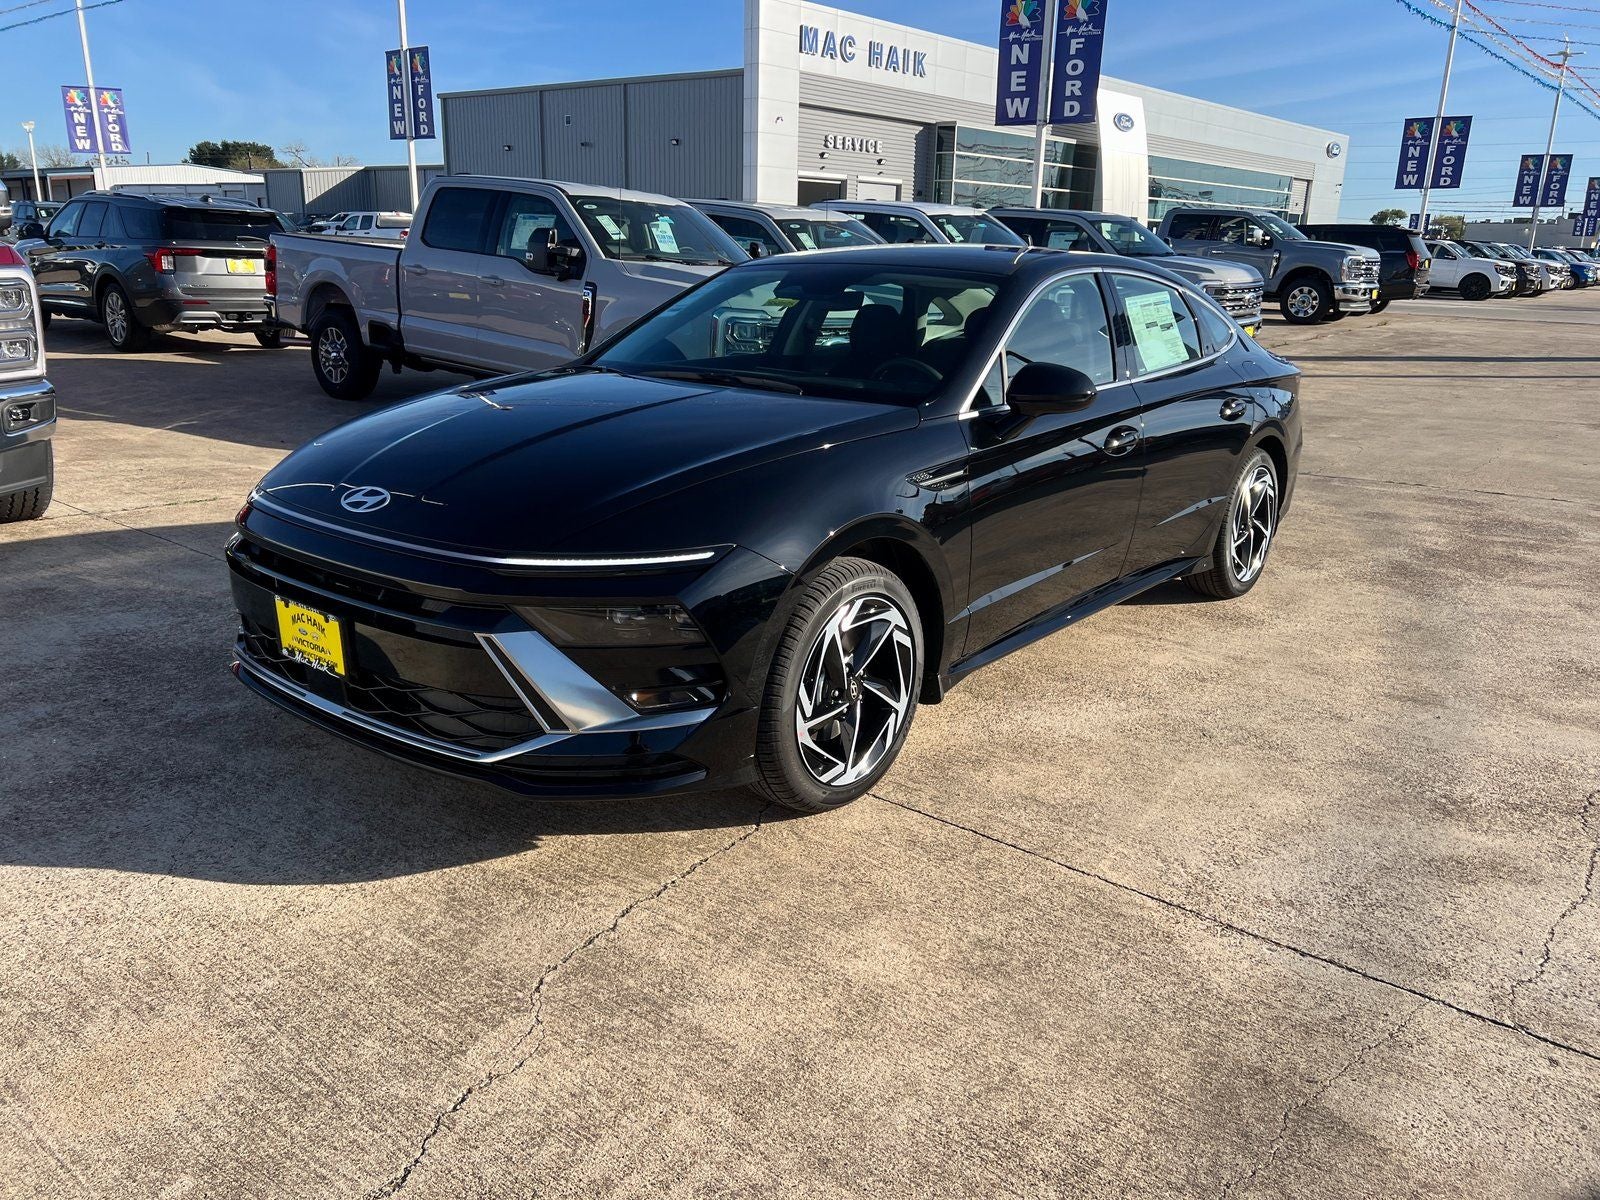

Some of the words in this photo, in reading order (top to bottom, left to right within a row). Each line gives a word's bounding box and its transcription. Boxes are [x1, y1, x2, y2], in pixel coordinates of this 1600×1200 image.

[799, 24, 857, 63] MAC
[867, 40, 928, 78] HAIK
[1005, 43, 1030, 119] NEW
[1063, 37, 1085, 117] FORD
[392, 85, 405, 135] NEW
[417, 84, 428, 136] FORD
[73, 112, 91, 150] NEW
[107, 114, 123, 151] FORD
[823, 134, 884, 154] SERVICE
[1402, 146, 1421, 186] NEW
[1439, 145, 1457, 186] FORD
[1519, 175, 1534, 205] NEW
[1547, 175, 1561, 205] FORD
[1587, 193, 1599, 217] NEW
[291, 612, 306, 626] MAC
[306, 614, 326, 636] HAIK
